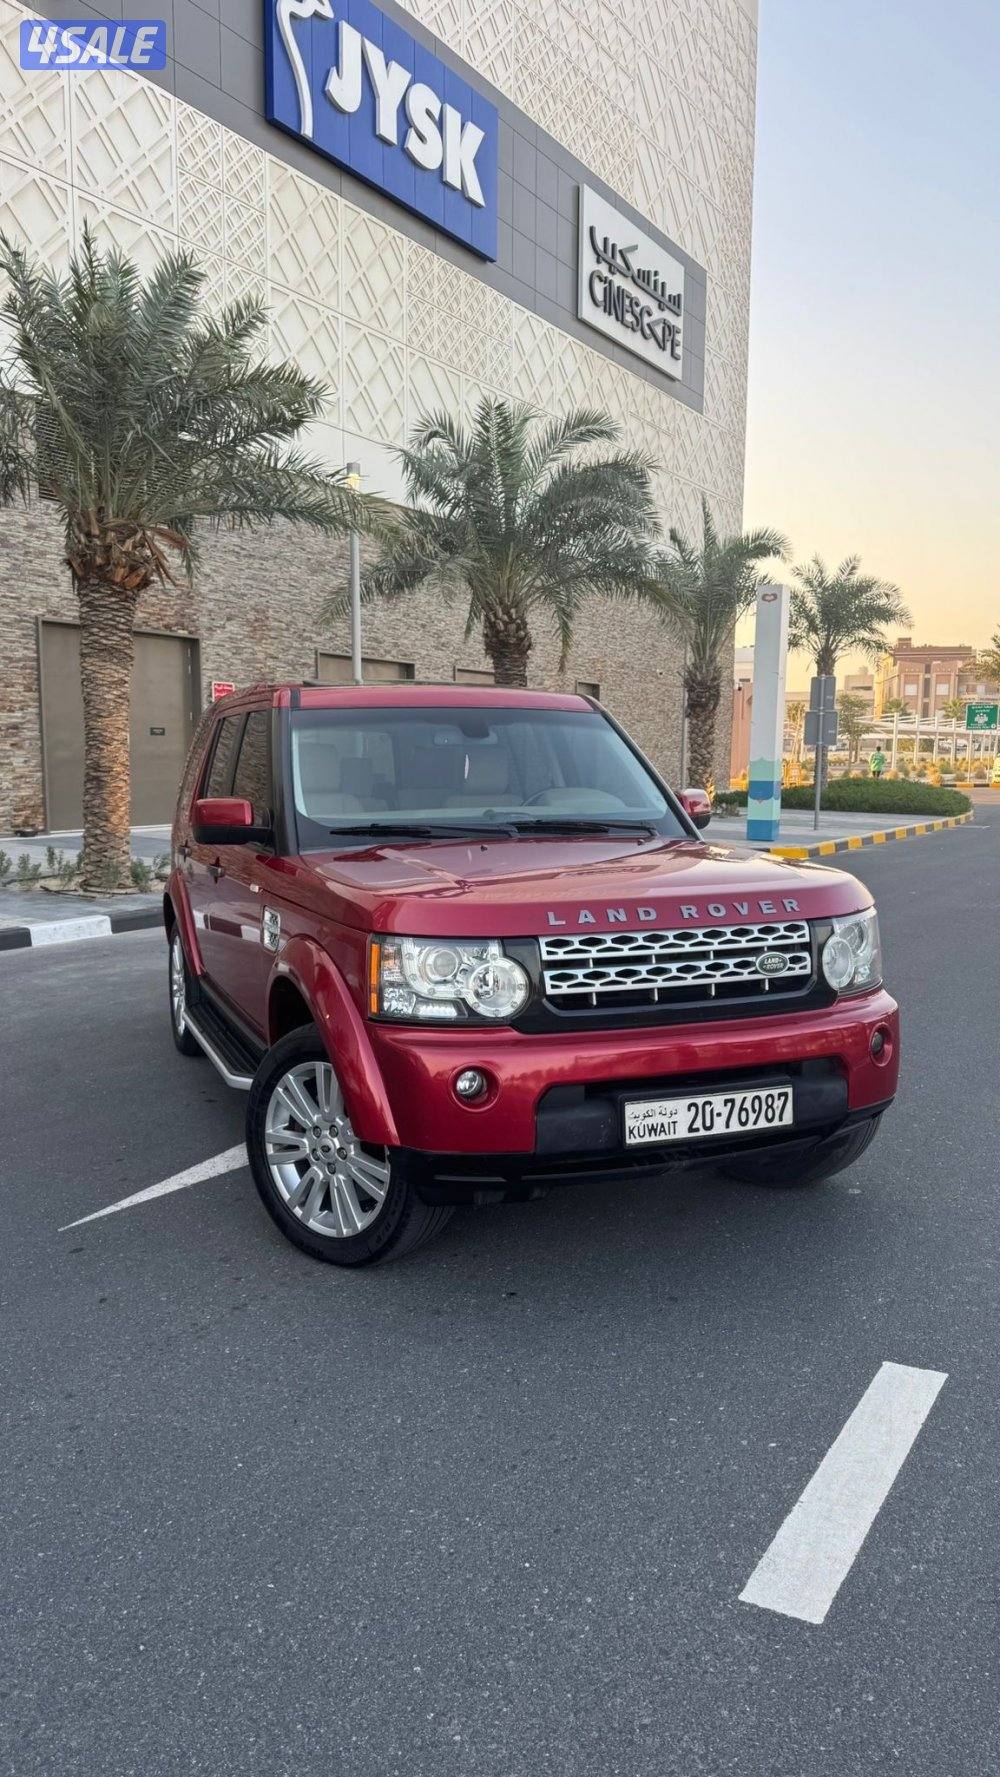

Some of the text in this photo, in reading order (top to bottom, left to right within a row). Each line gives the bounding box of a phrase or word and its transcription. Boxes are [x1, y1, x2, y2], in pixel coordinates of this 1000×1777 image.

[325, 21, 487, 208] JYSK
[547, 898, 801, 927] LAND ROVER
[628, 1091, 789, 1139] KUWAIT 20-76987
